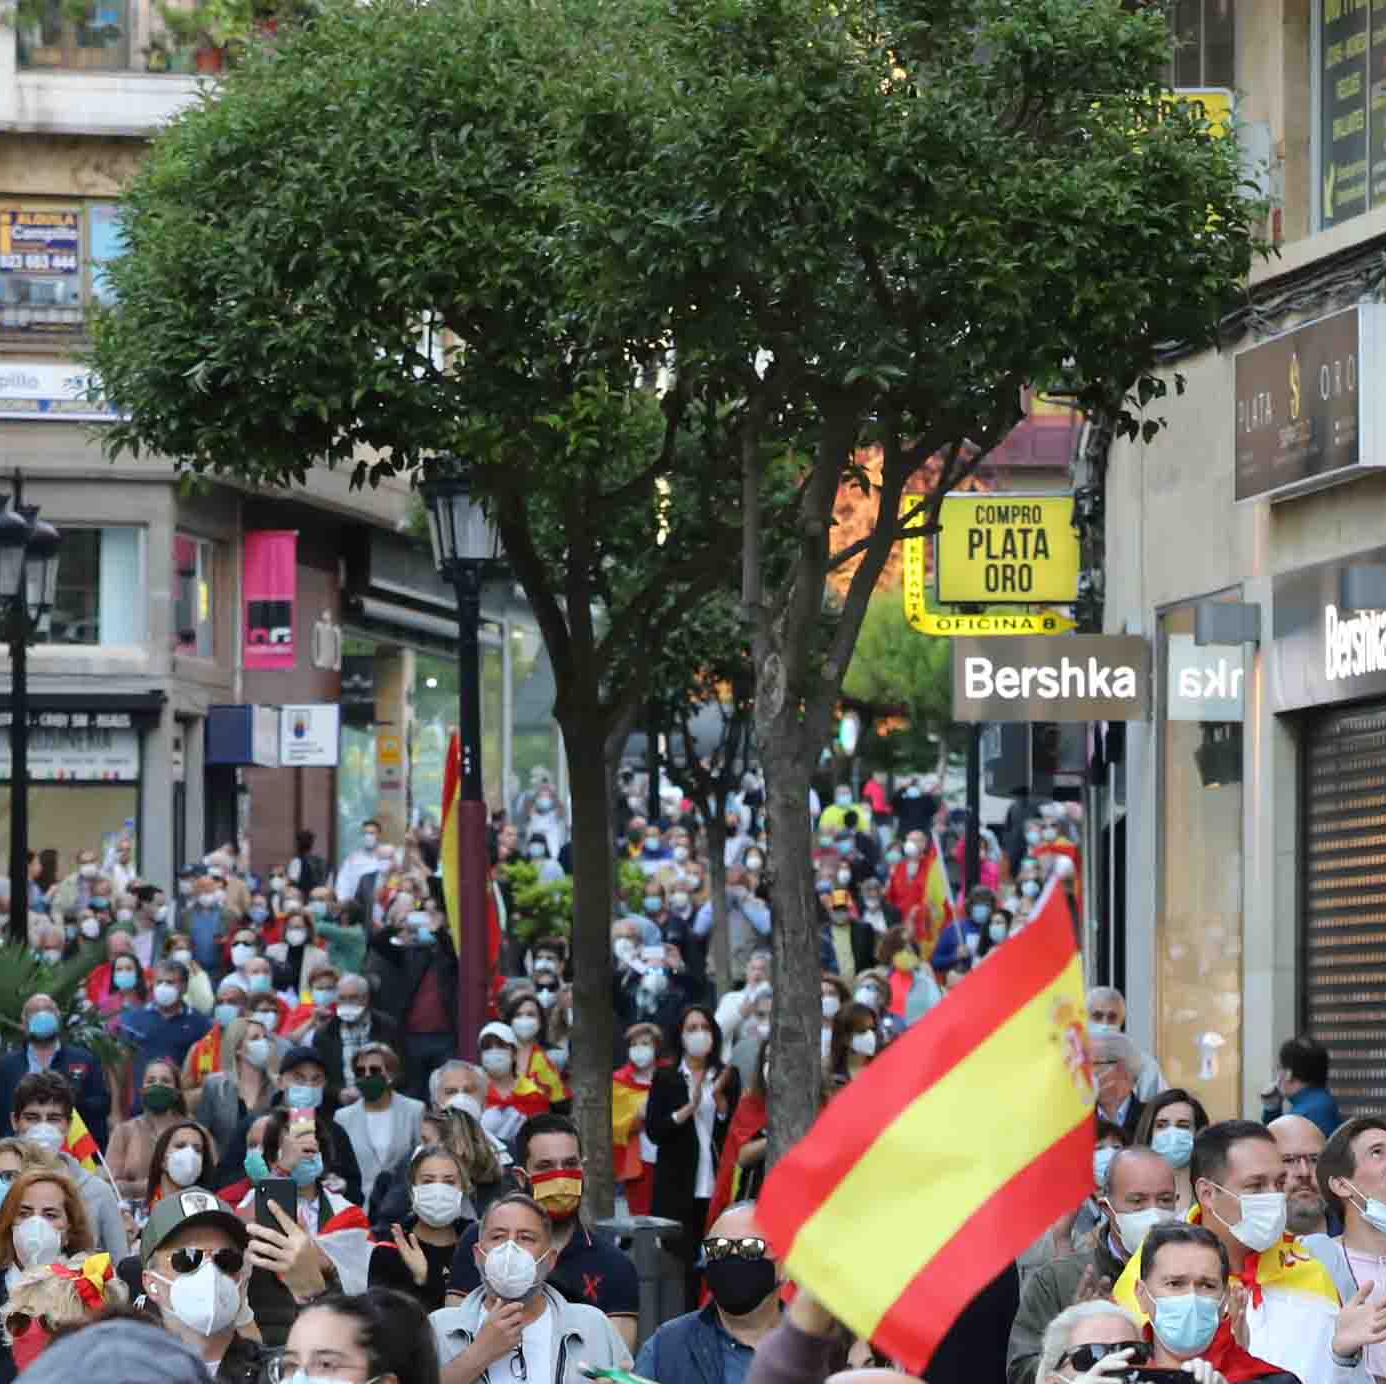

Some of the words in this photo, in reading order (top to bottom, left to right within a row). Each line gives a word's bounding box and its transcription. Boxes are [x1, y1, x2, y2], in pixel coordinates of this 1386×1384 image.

[975, 504, 1043, 525] COMPRO
[968, 528, 1050, 560] PLATA
[985, 563, 1033, 593] ORO
[936, 618, 1034, 631] OFICINA
[965, 656, 1136, 699] Bershka
